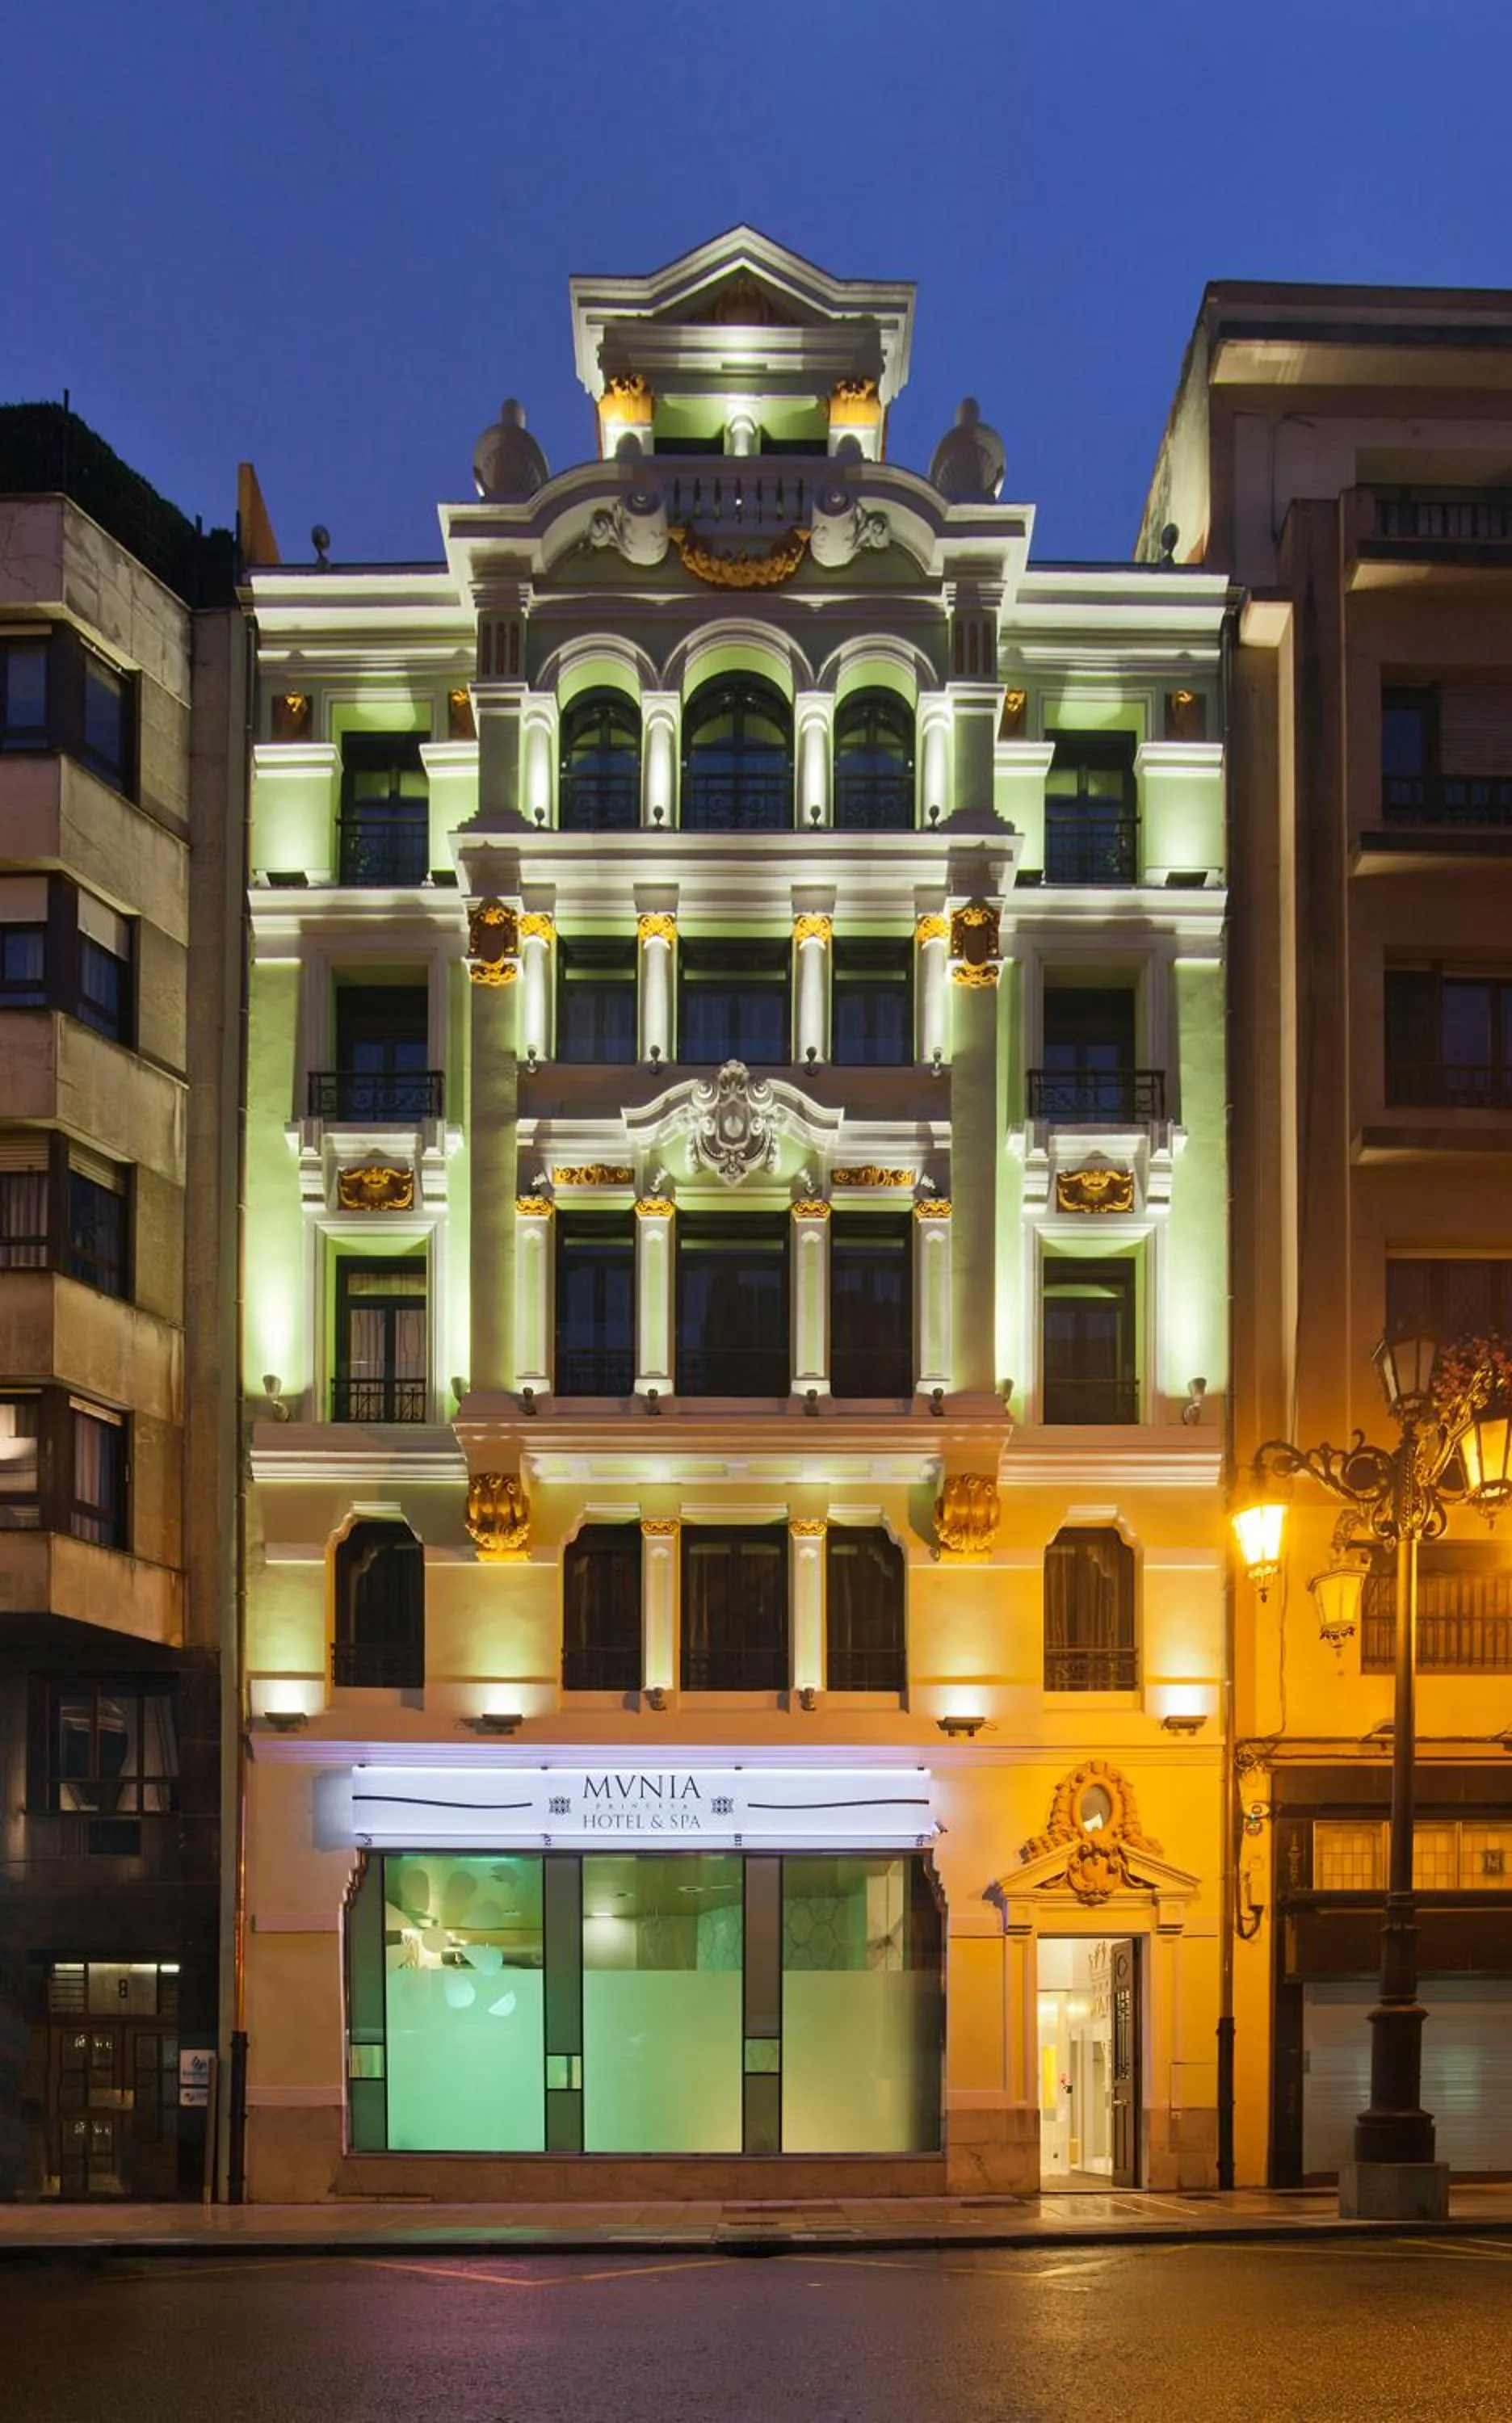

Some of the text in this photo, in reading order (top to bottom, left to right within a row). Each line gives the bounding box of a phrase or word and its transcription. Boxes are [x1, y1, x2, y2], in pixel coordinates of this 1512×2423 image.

[583, 1775, 701, 1799] MVNIA
[583, 1815, 700, 1829] HOTEL & SPA
[118, 1979, 128, 1998] 8
